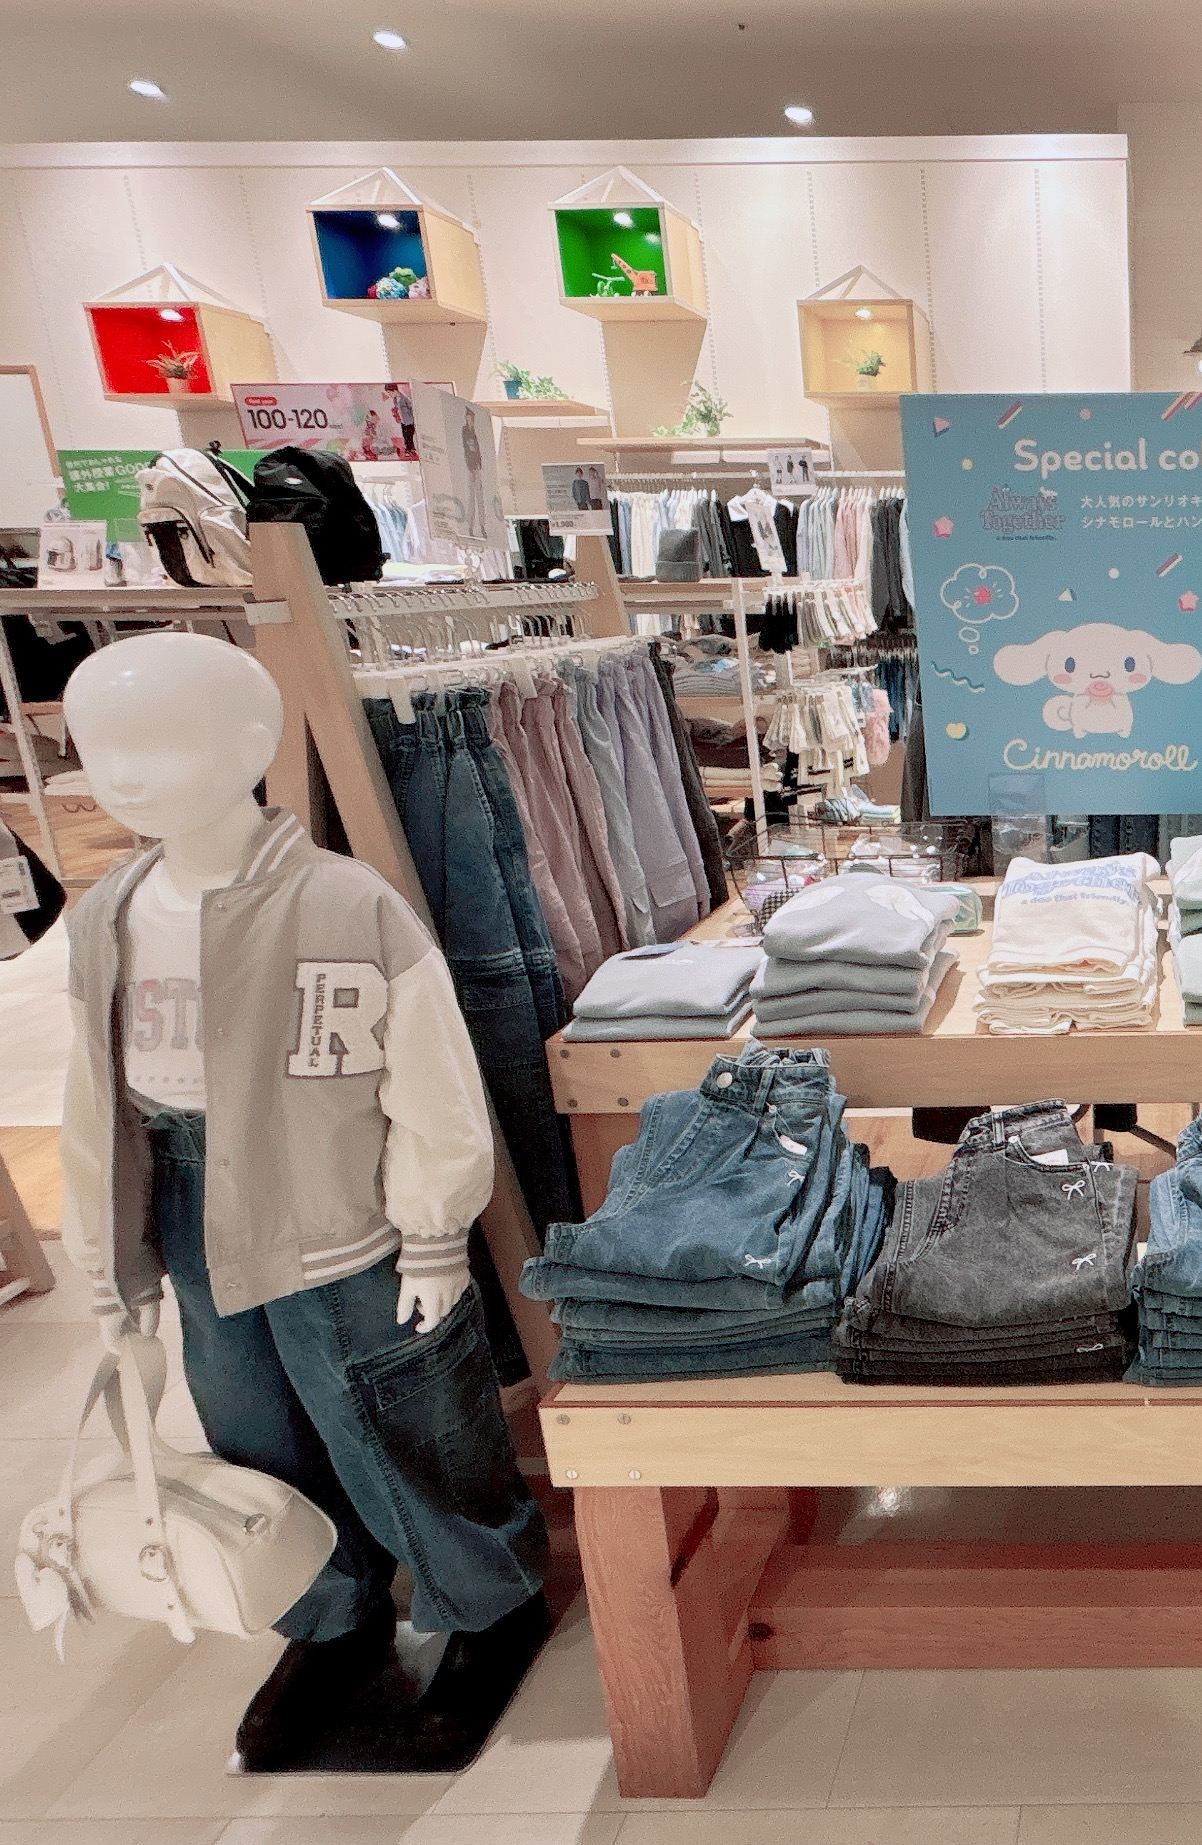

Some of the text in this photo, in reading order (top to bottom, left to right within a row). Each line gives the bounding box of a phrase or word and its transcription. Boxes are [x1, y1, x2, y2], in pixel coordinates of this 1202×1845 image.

[247, 408, 329, 430] 100-120
[1013, 437, 1148, 480] Special
[987, 486, 1058, 511] Always
[980, 509, 1066, 534] Together
[1003, 738, 1198, 771] Cinnamoroll
[307, 972, 326, 1068] PERPETUAL
